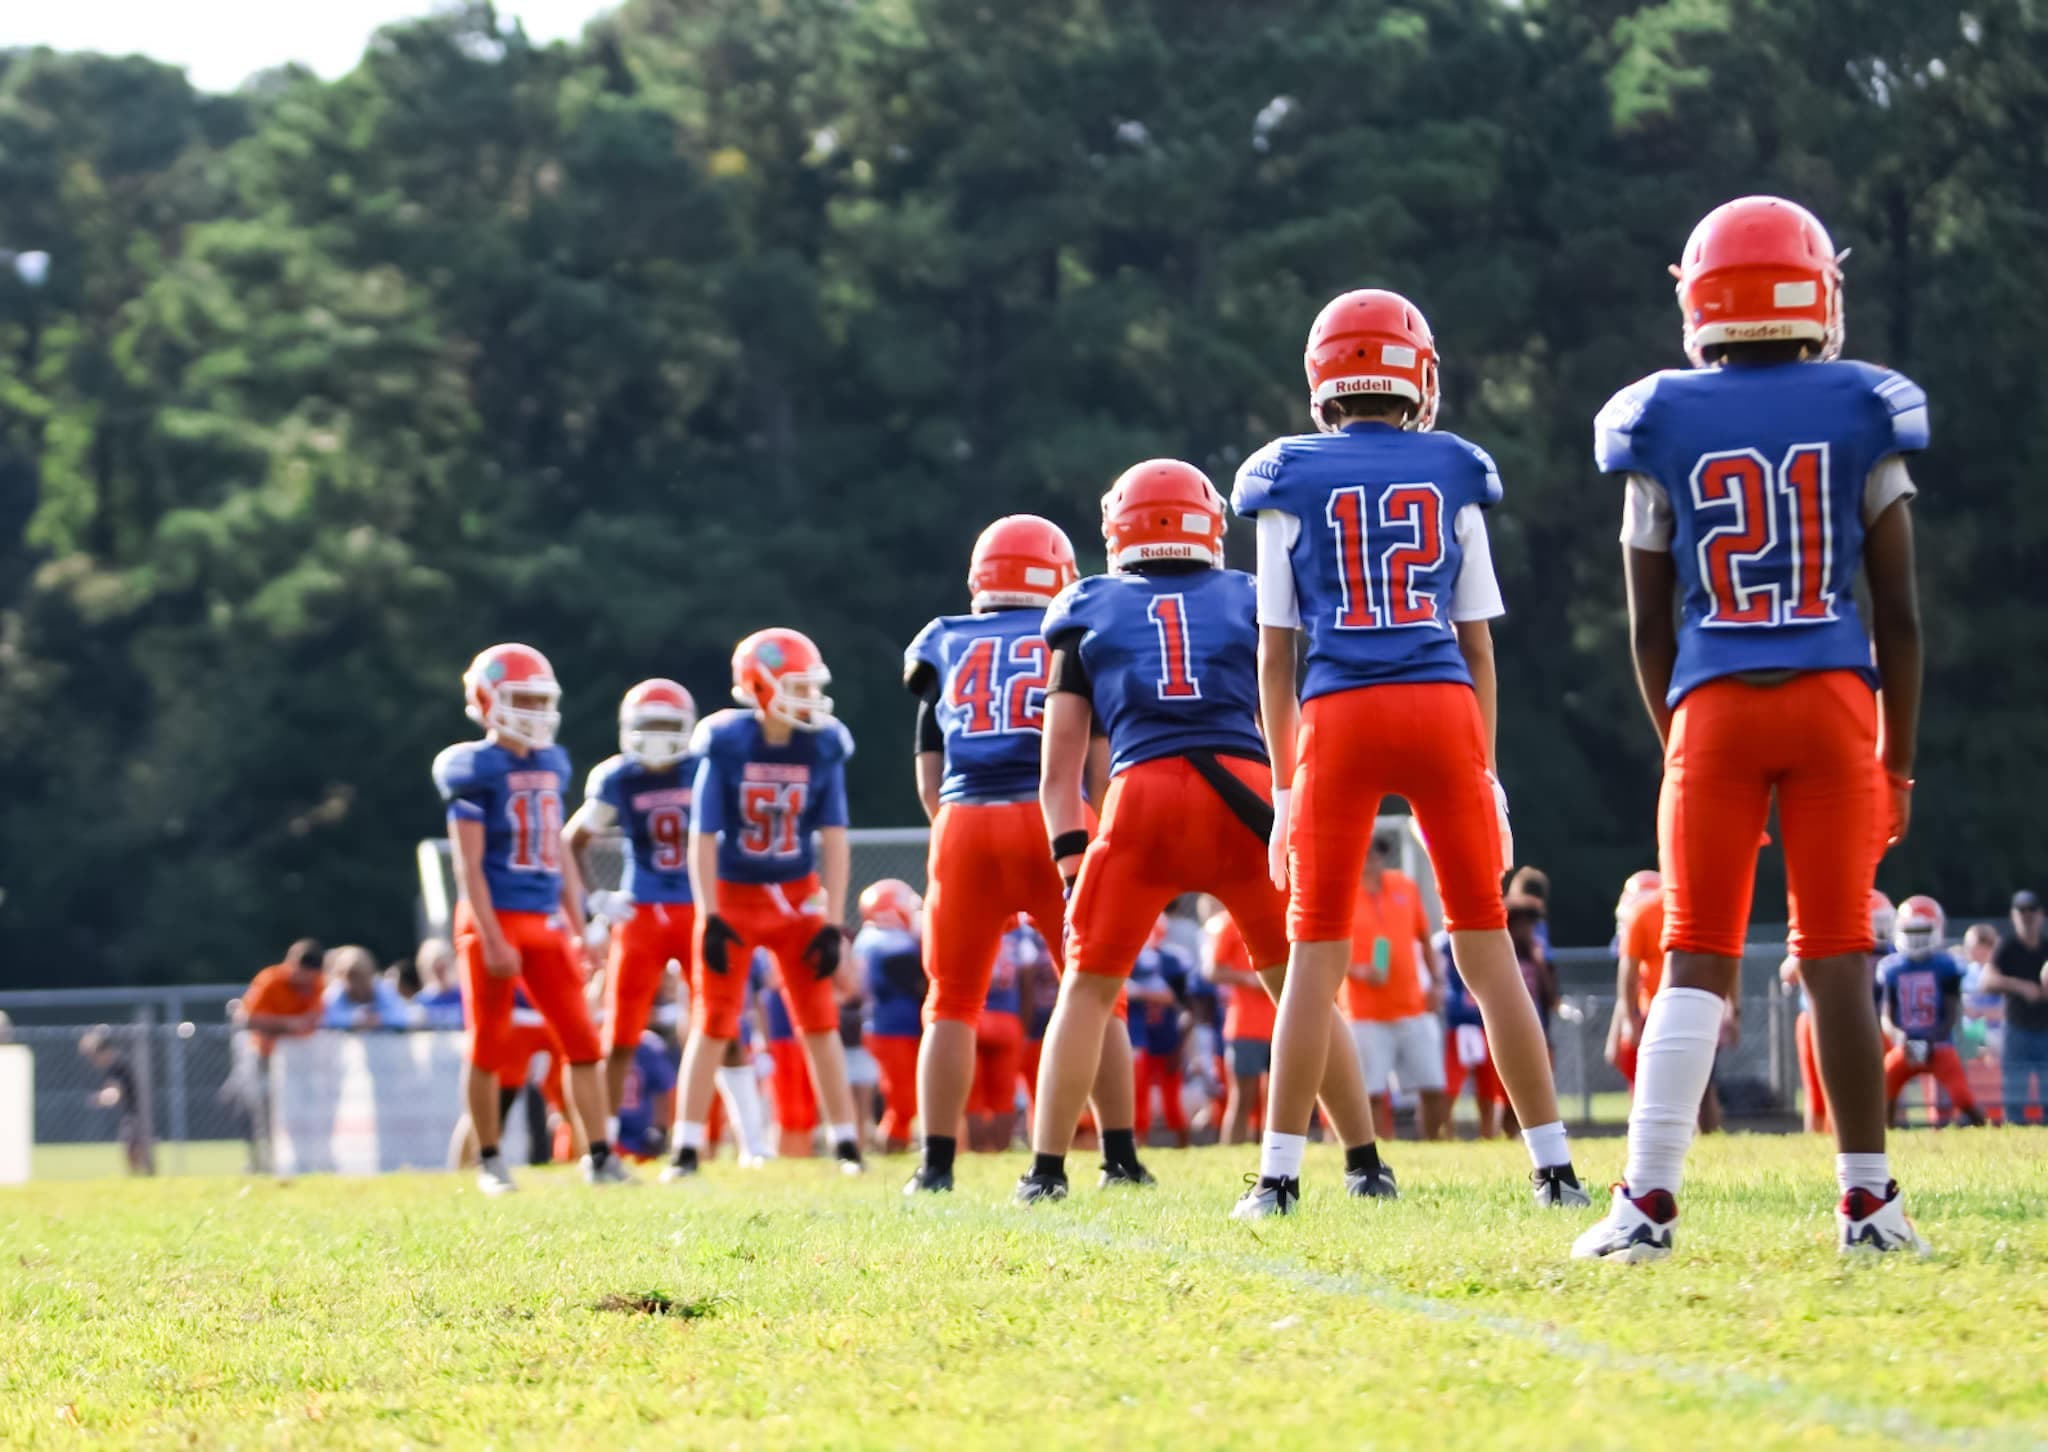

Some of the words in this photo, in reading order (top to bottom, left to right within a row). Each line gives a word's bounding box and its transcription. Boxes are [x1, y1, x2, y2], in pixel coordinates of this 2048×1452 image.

[1336, 379, 1392, 394] Riddell
[1140, 546, 1191, 558] Riddell
[1326, 482, 1445, 630] 12
[1689, 442, 1840, 628] 21
[949, 636, 1050, 737] 42
[1148, 593, 1202, 700] 1
[649, 806, 688, 870] 9
[739, 783, 808, 858] 51
